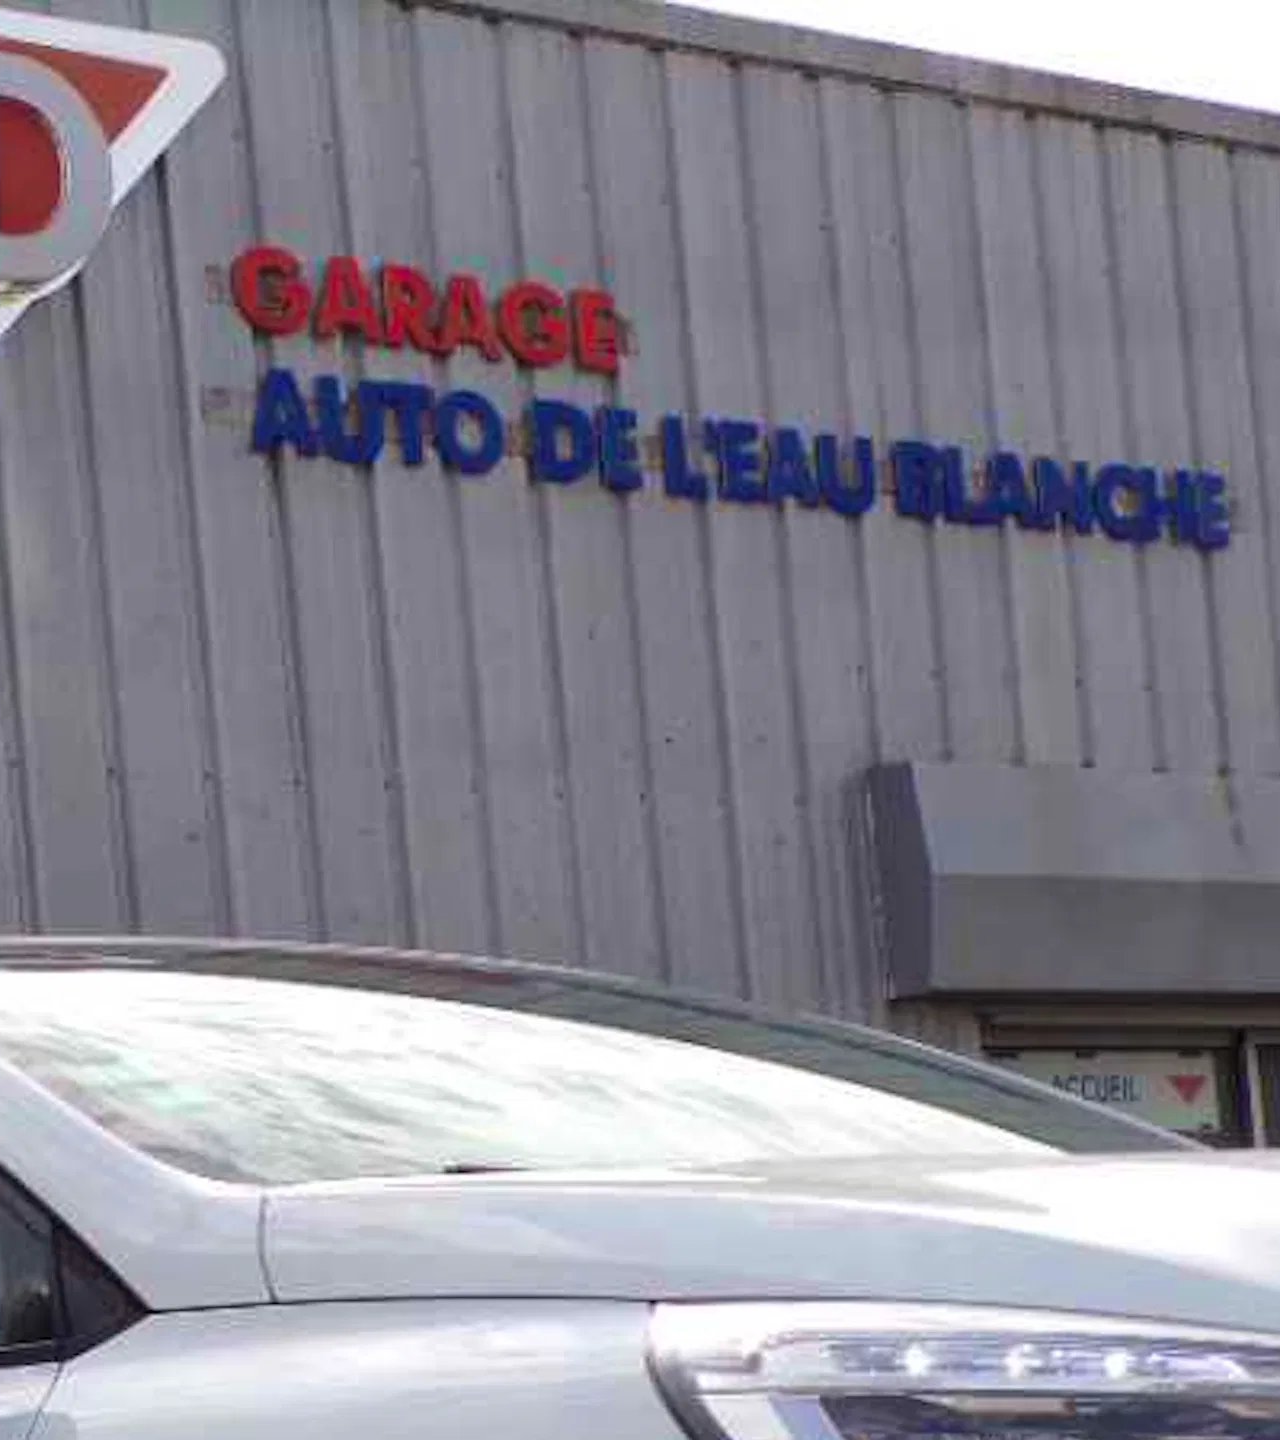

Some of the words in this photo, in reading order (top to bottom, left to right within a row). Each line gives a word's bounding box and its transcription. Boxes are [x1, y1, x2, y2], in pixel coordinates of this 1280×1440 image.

[230, 245, 618, 373] GARAGE
[253, 367, 505, 475] AUTO
[531, 398, 643, 494] DE
[662, 409, 877, 515] L'EAU
[890, 440, 1230, 552] BLANCHE
